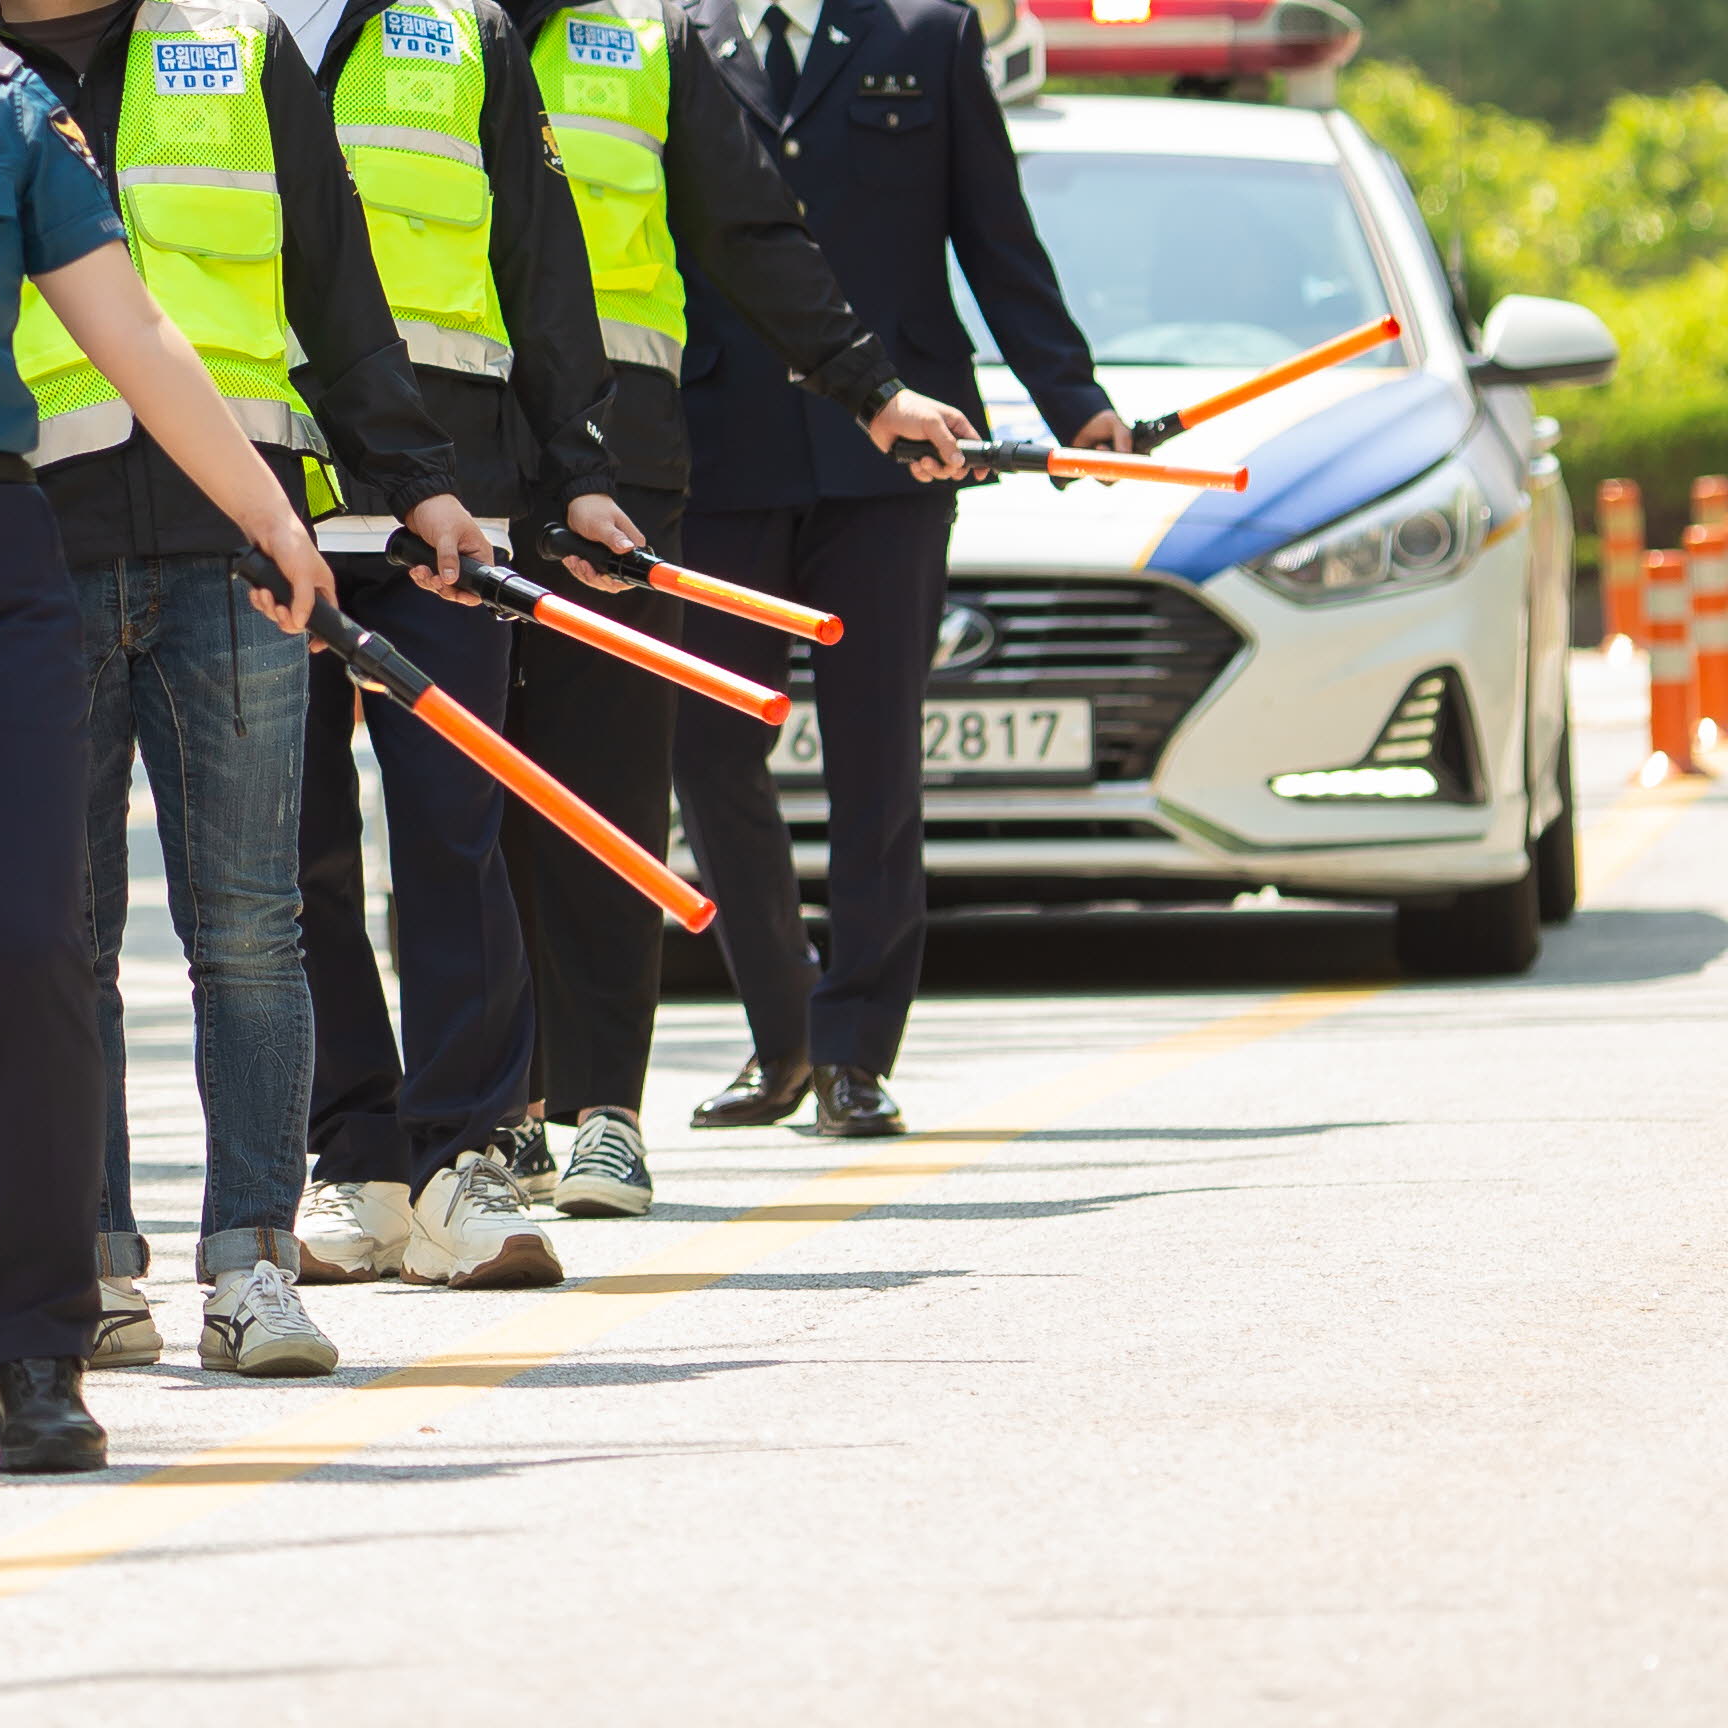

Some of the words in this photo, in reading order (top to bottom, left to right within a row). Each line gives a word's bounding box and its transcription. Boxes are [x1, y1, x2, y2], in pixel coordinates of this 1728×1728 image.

[388, 13, 453, 42] 유원대학교
[161, 45, 235, 70] 유원대학교
[390, 36, 452, 57] YDCP
[574, 46, 632, 64] YDCP
[164, 73, 234, 89] YDCP
[924, 710, 1062, 763] 2817
